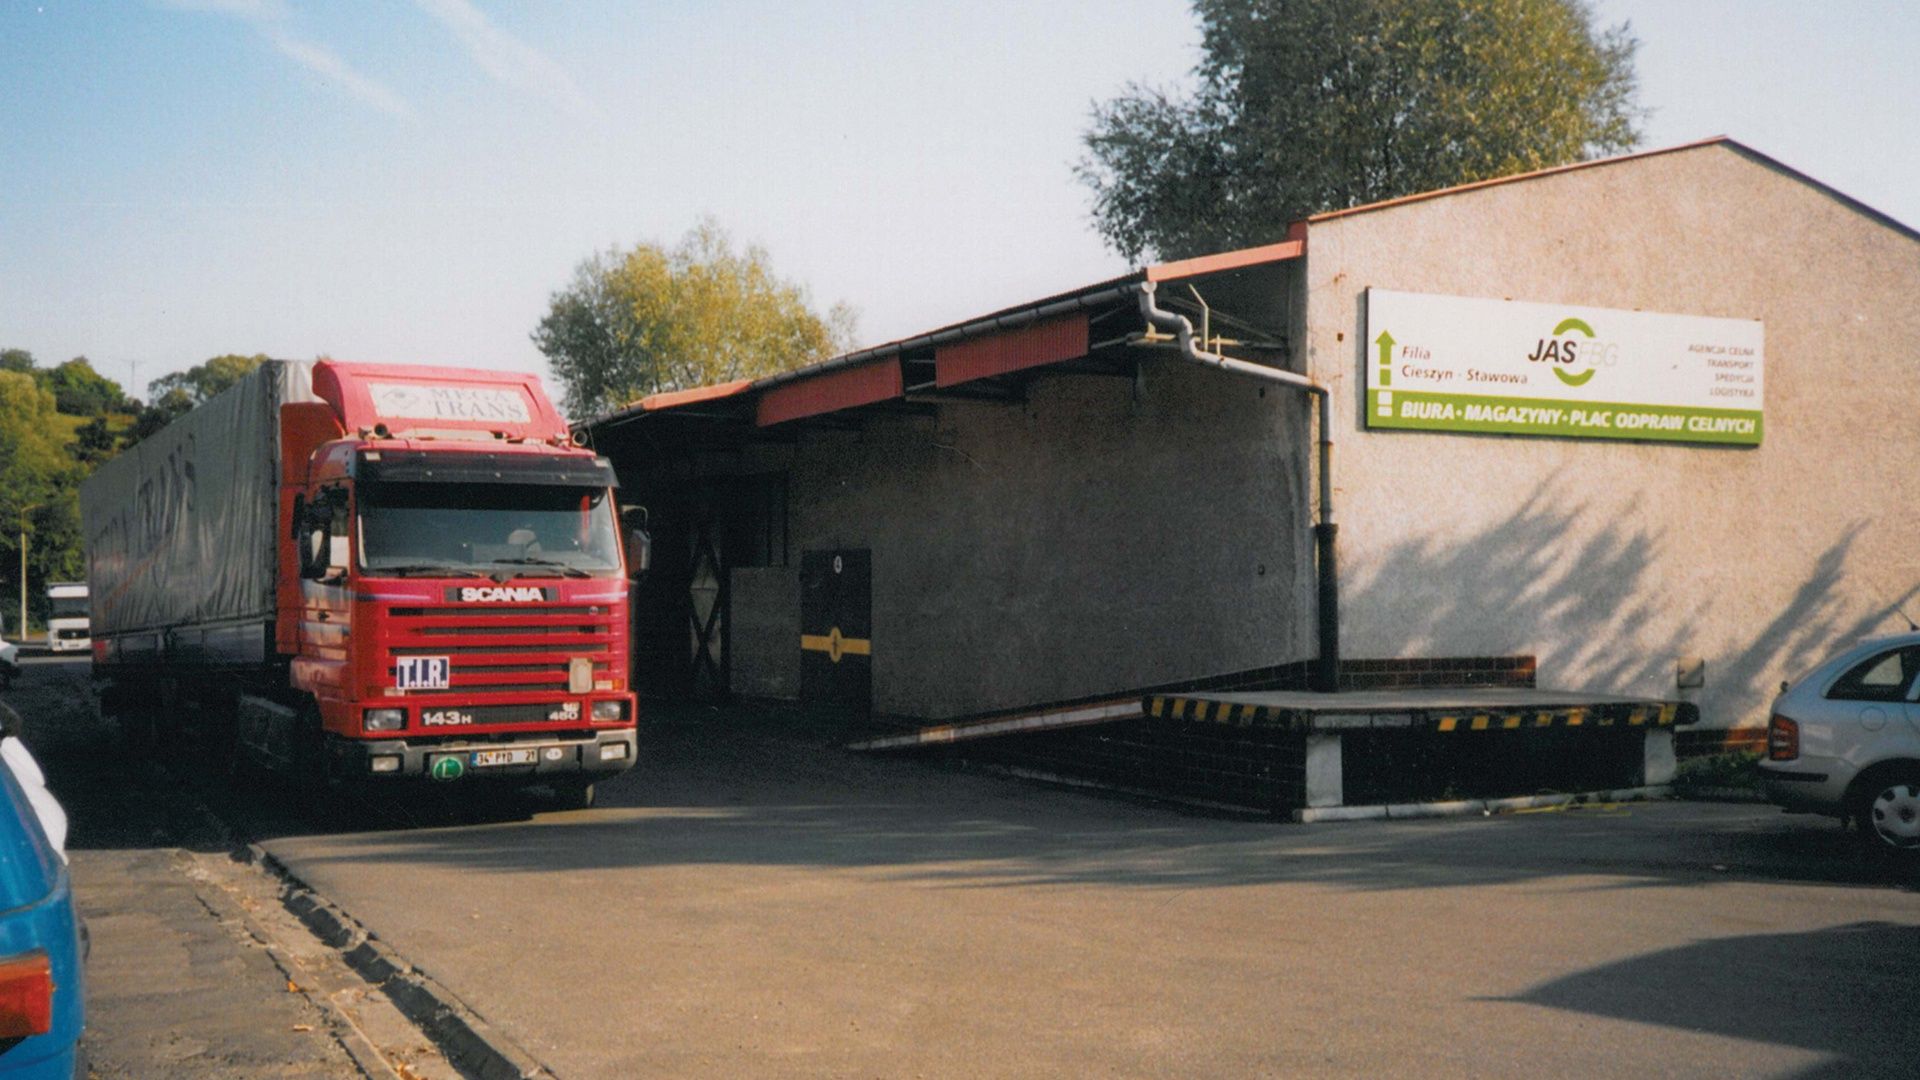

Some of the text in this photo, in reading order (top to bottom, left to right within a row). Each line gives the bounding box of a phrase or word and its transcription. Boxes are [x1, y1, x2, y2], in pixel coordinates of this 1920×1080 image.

[1402, 345, 1431, 360] Filia
[1688, 344, 1754, 356] AGENCJA CELNA
[1707, 359, 1754, 369] TRANSPORT
[1402, 364, 1528, 385] Cieszyn Stawowa
[1710, 387, 1754, 397] LOGISTYKA
[428, 399, 523, 419] TRANS
[1401, 401, 1755, 434] BIURA MAGAZYNY PLAC ODPRAW CELNYCH
[461, 587, 544, 602] SCANIA
